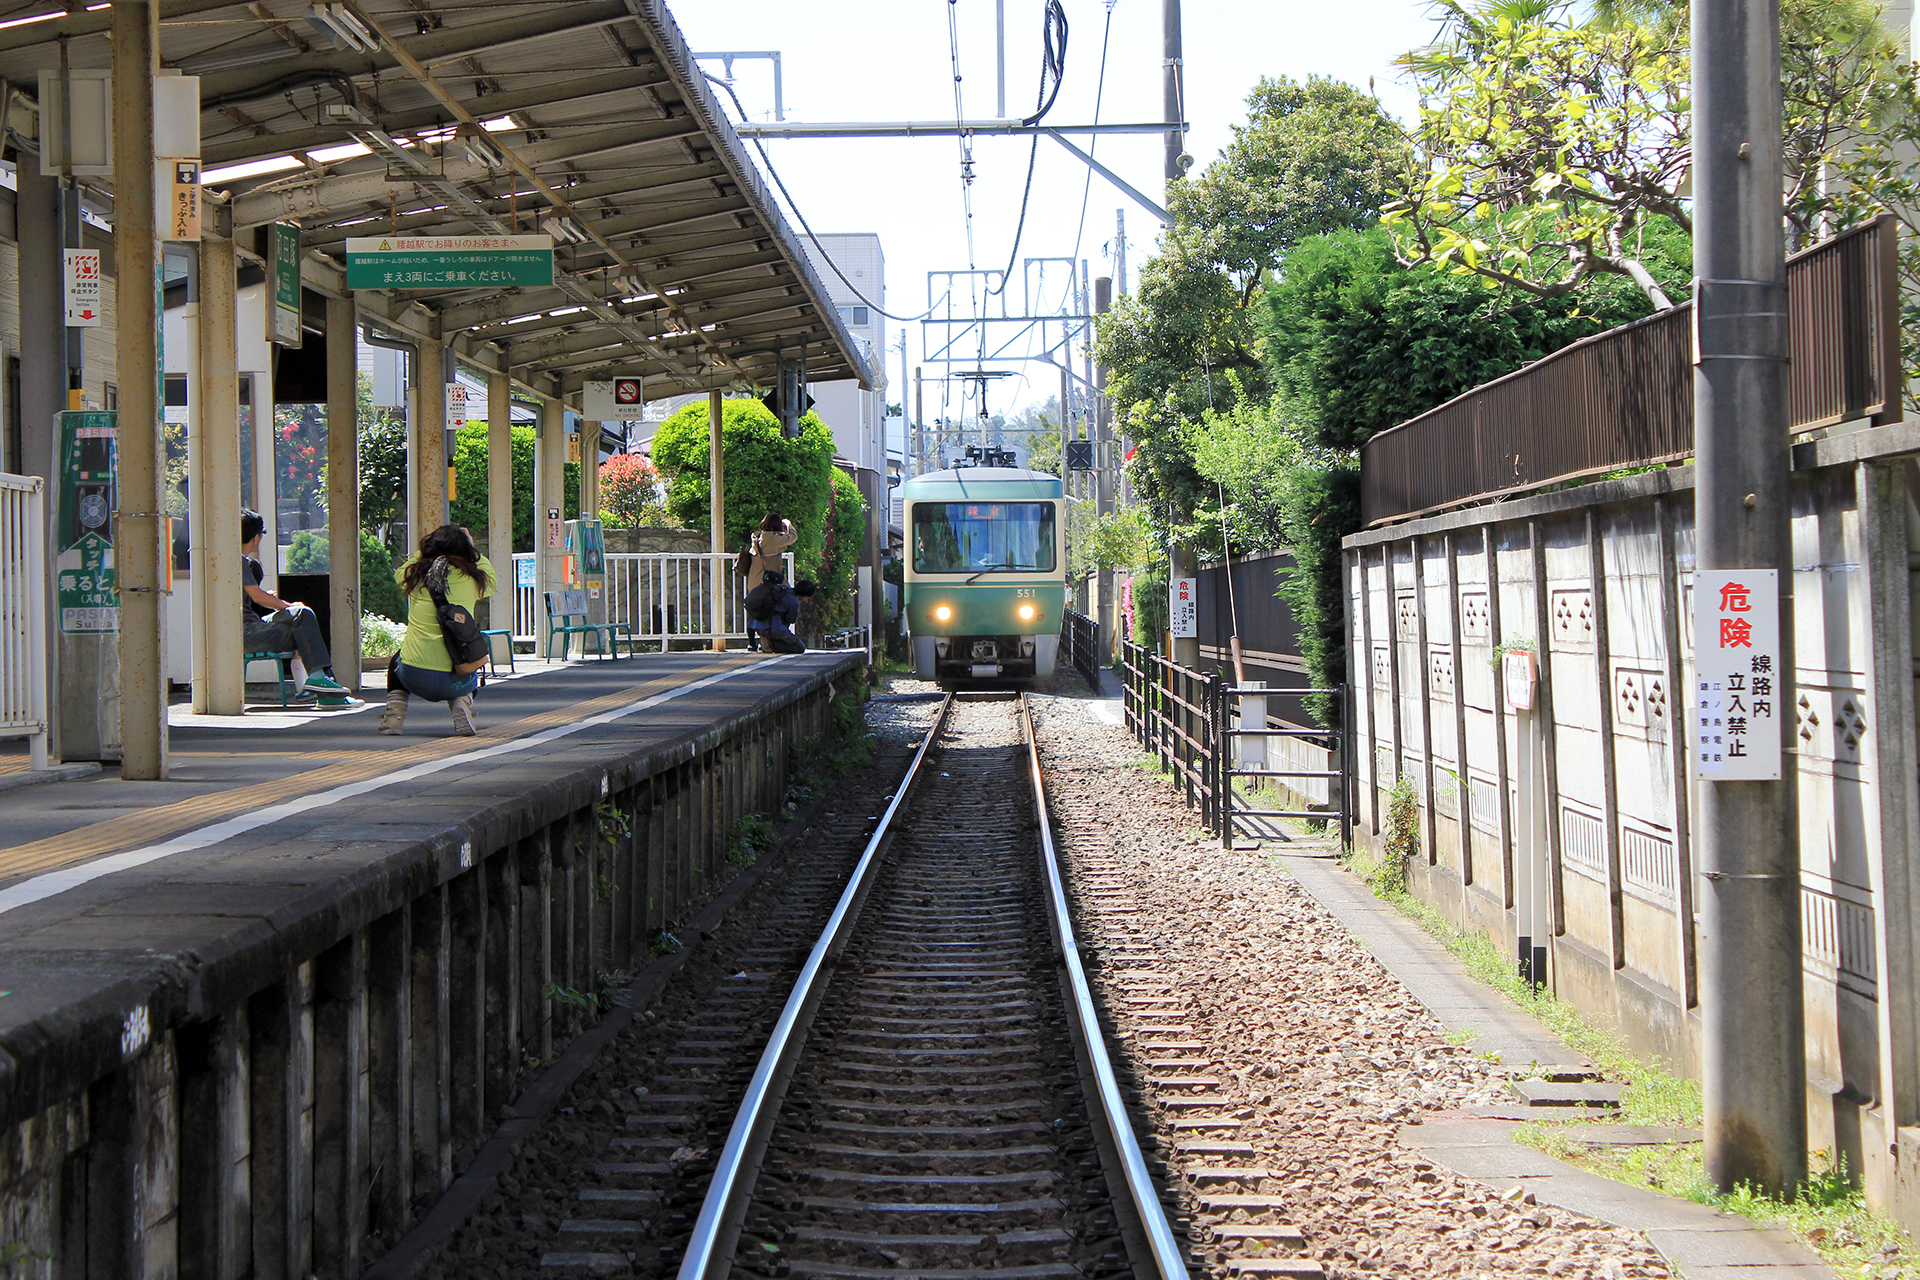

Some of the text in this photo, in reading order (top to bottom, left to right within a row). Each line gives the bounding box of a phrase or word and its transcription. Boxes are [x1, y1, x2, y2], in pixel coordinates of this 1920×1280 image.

[177, 192, 188, 237] きっぷ入れ
[396, 239, 520, 249] 腰越駅でお降りのお客さまへ
[383, 270, 516, 283] まえ3両にご乗車ください。
[76, 429, 117, 438] PASMO
[86, 538, 99, 571] タッチ
[1017, 589, 1036, 598] 551
[1179, 581, 1189, 600] 危険
[1719, 582, 1753, 649] 危険
[1751, 654, 1772, 719] 線路内
[1700, 682, 1710, 763] 鎌倉警察署
[1713, 682, 1723, 763] 江ノ島電鉄
[1727, 672, 1748, 758] 立入禁止
